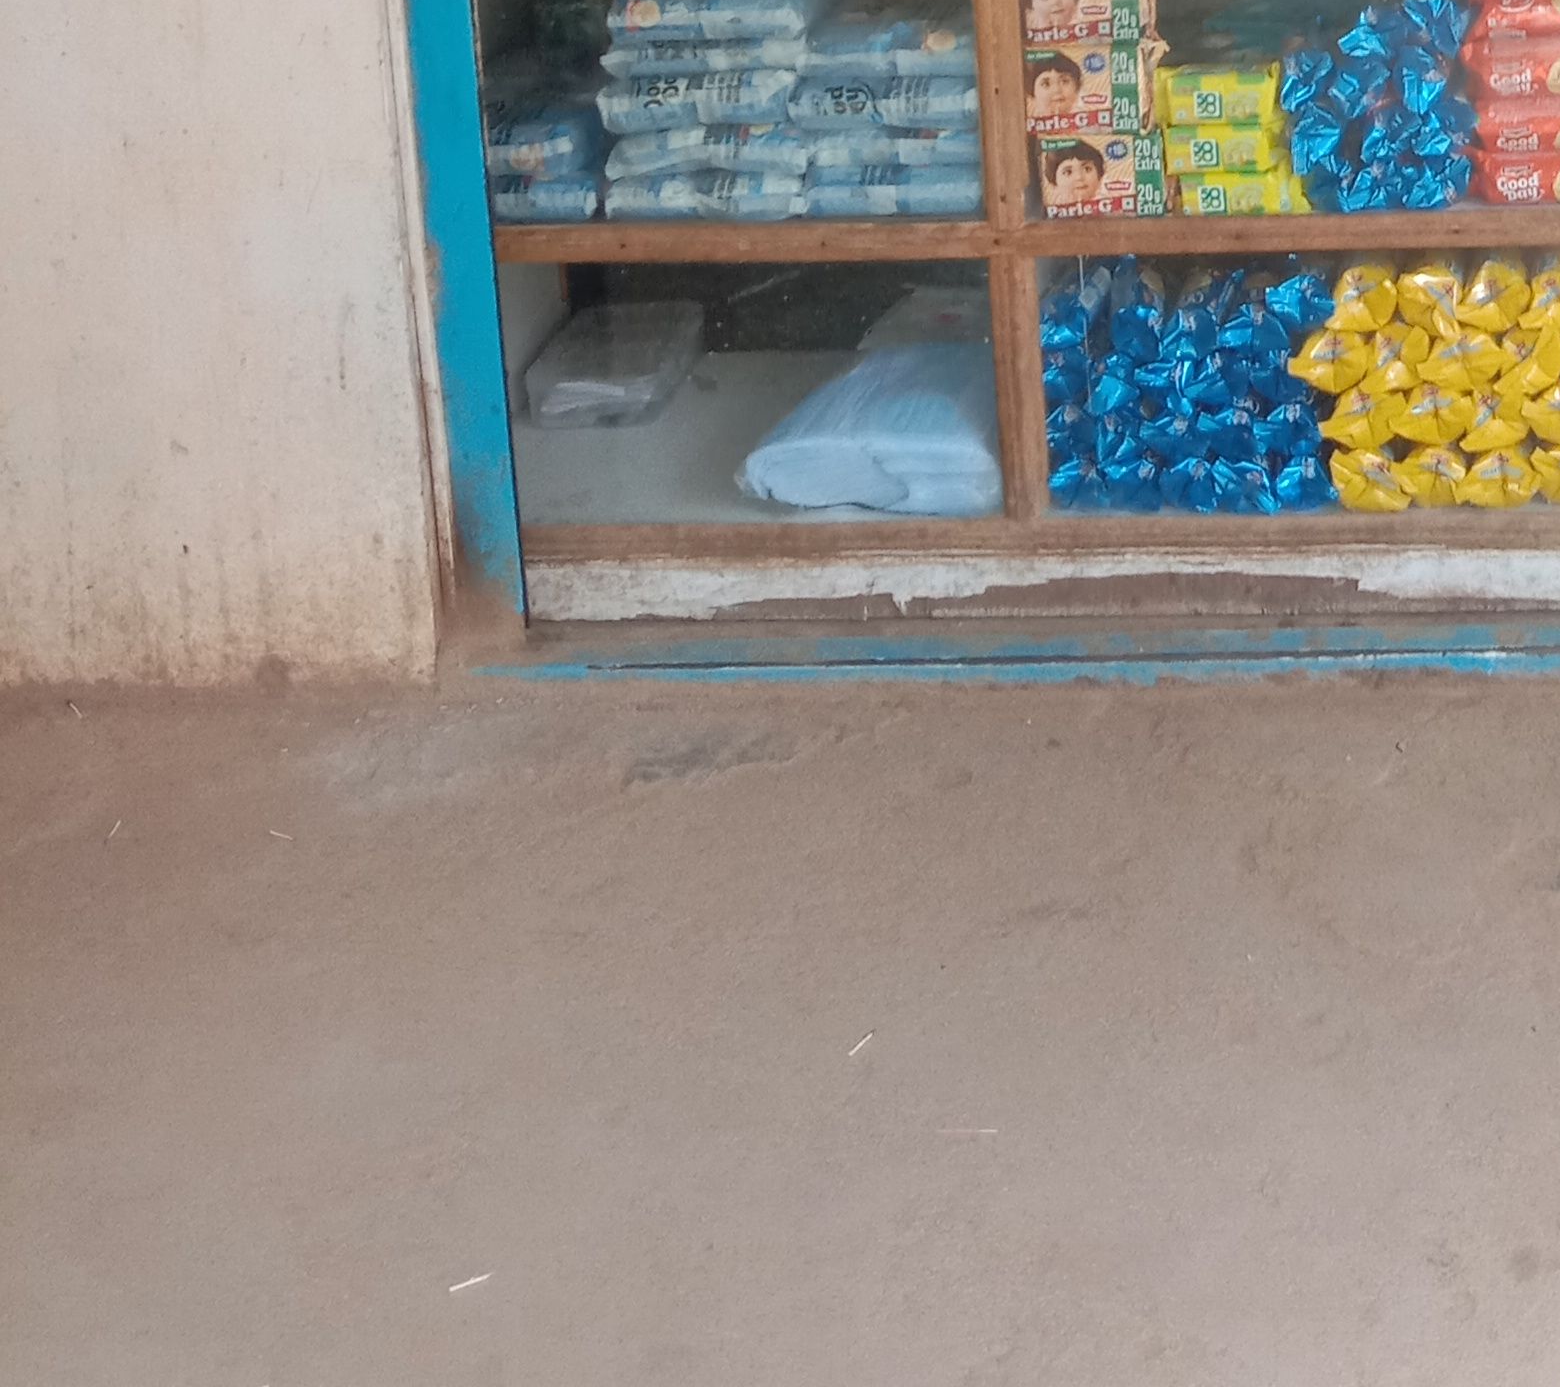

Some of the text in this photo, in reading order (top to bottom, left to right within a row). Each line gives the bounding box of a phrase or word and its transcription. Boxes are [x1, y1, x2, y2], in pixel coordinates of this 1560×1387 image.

[1113, 27, 1140, 40] Extra
[1112, 72, 1137, 85] Extra
[1026, 113, 1089, 133] Parle-G
[1113, 117, 1140, 130] Extra
[1135, 155, 1161, 171] Extra
[1497, 172, 1539, 191] Good
[1046, 197, 1113, 219] Parle-G
[1137, 201, 1164, 216] Extra
